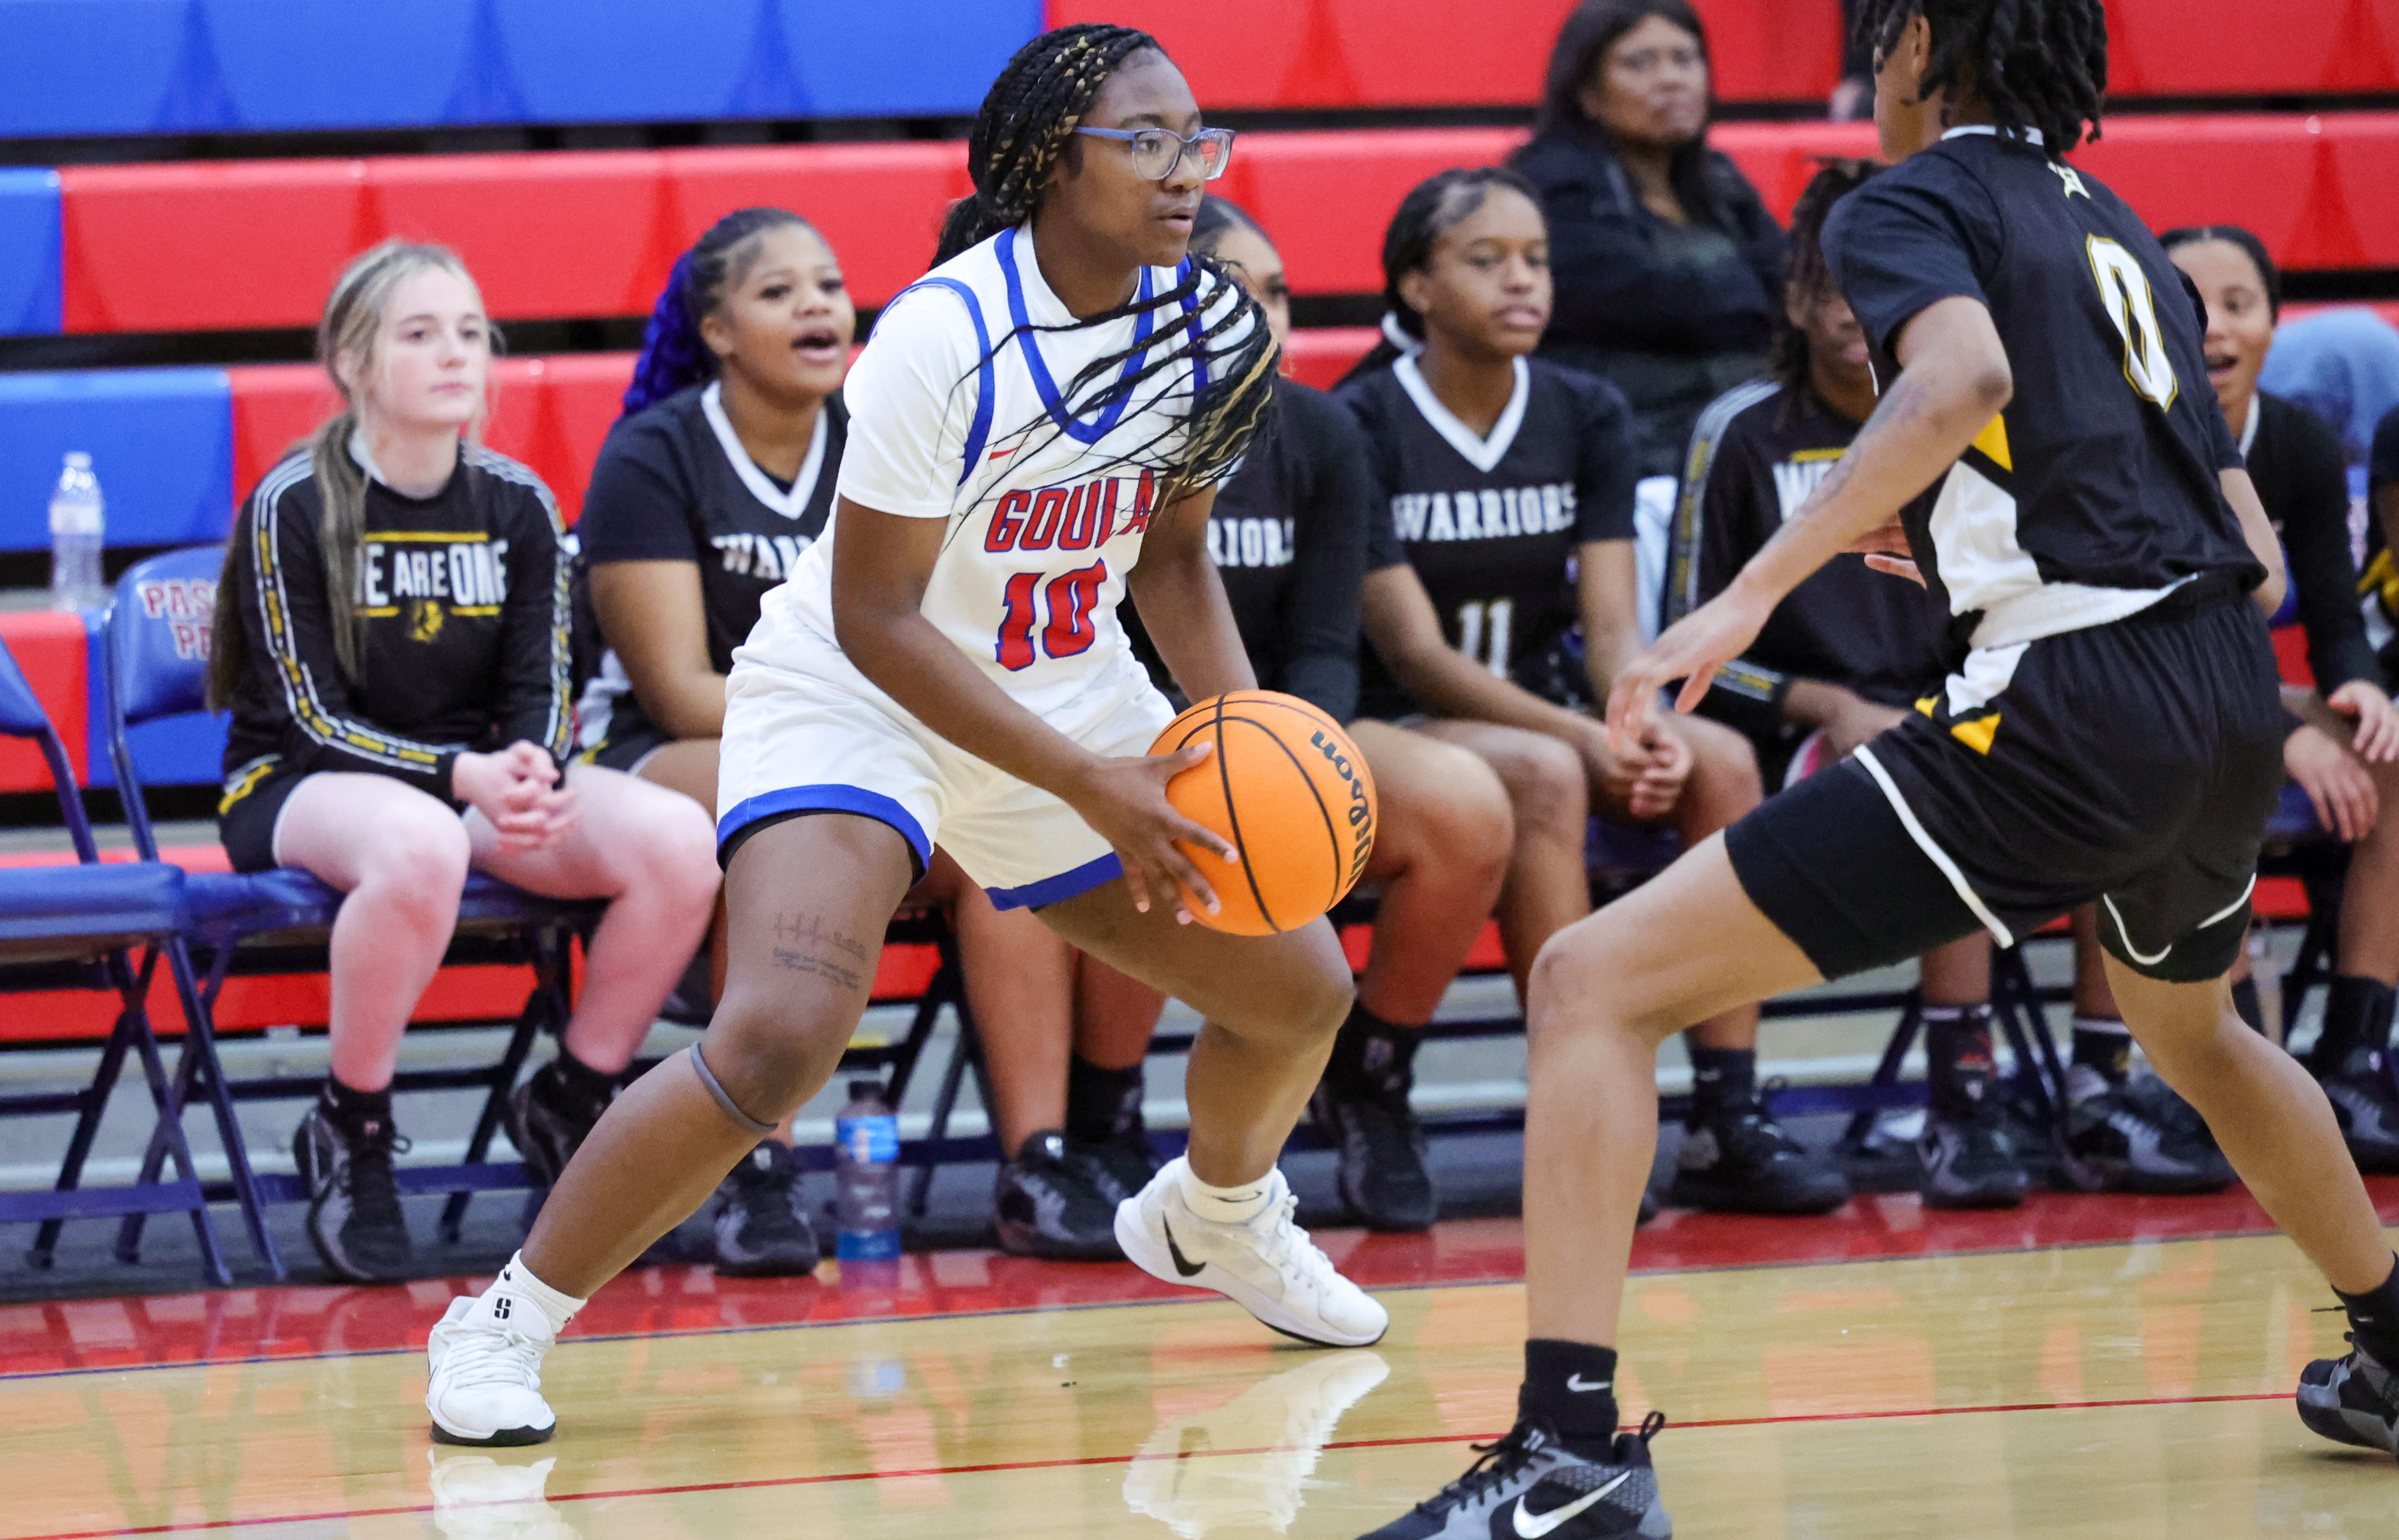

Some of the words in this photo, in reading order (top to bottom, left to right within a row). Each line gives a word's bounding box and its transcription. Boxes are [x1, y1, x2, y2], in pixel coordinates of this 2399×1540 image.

[2086, 233, 2179, 413] 0
[1391, 482, 1578, 541] WARRIORS
[393, 550, 449, 597] ARE
[448, 538, 509, 606] ONE
[996, 557, 1107, 671] 10
[1458, 597, 1514, 679] 11
